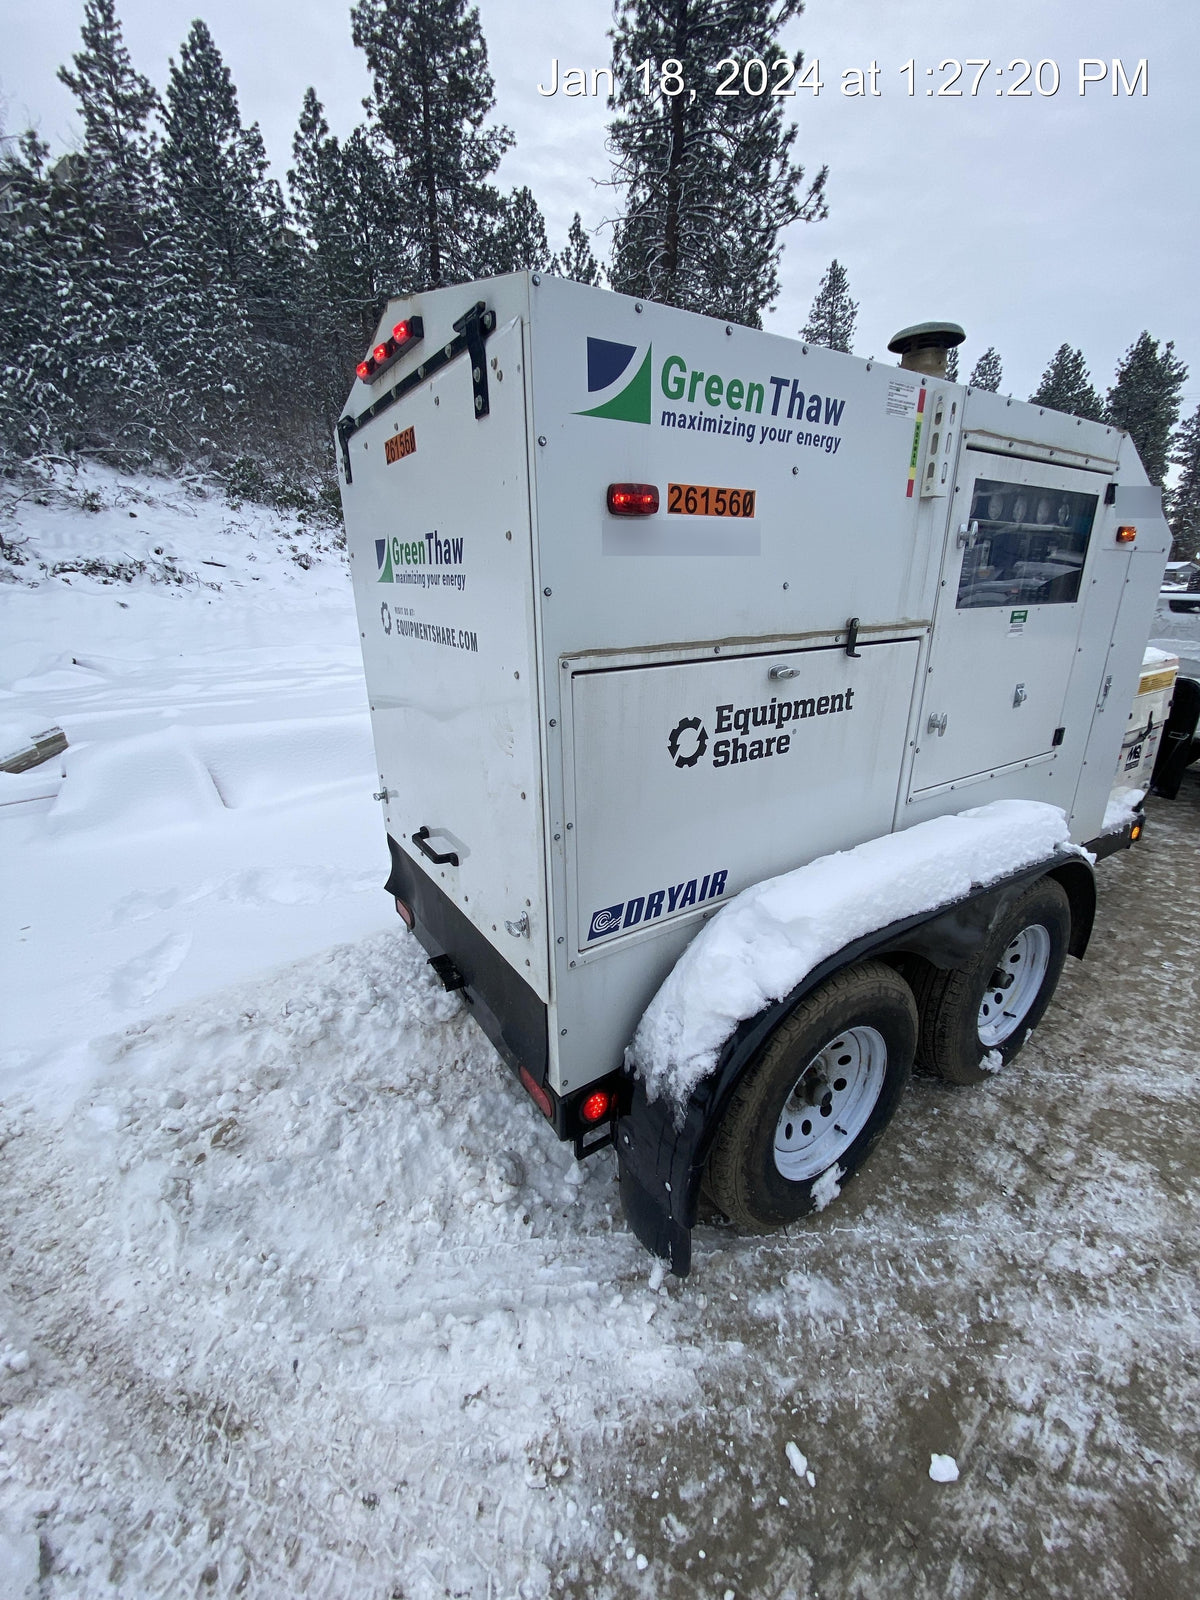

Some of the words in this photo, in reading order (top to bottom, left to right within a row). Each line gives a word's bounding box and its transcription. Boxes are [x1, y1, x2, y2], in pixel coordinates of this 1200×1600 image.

[384, 427, 416, 464] 261560
[660, 410, 756, 443] maximizing
[759, 425, 793, 445] your
[796, 431, 842, 454] energy
[668, 485, 755, 517] 261560
[395, 570, 426, 588] maximizing
[426, 573, 441, 589] your
[442, 573, 466, 591] energy
[396, 618, 478, 653] EQUIPMENTSHARE.COM
[714, 687, 855, 736] Equipment
[712, 734, 791, 768] Share
[622, 869, 729, 929] DRYAIR
